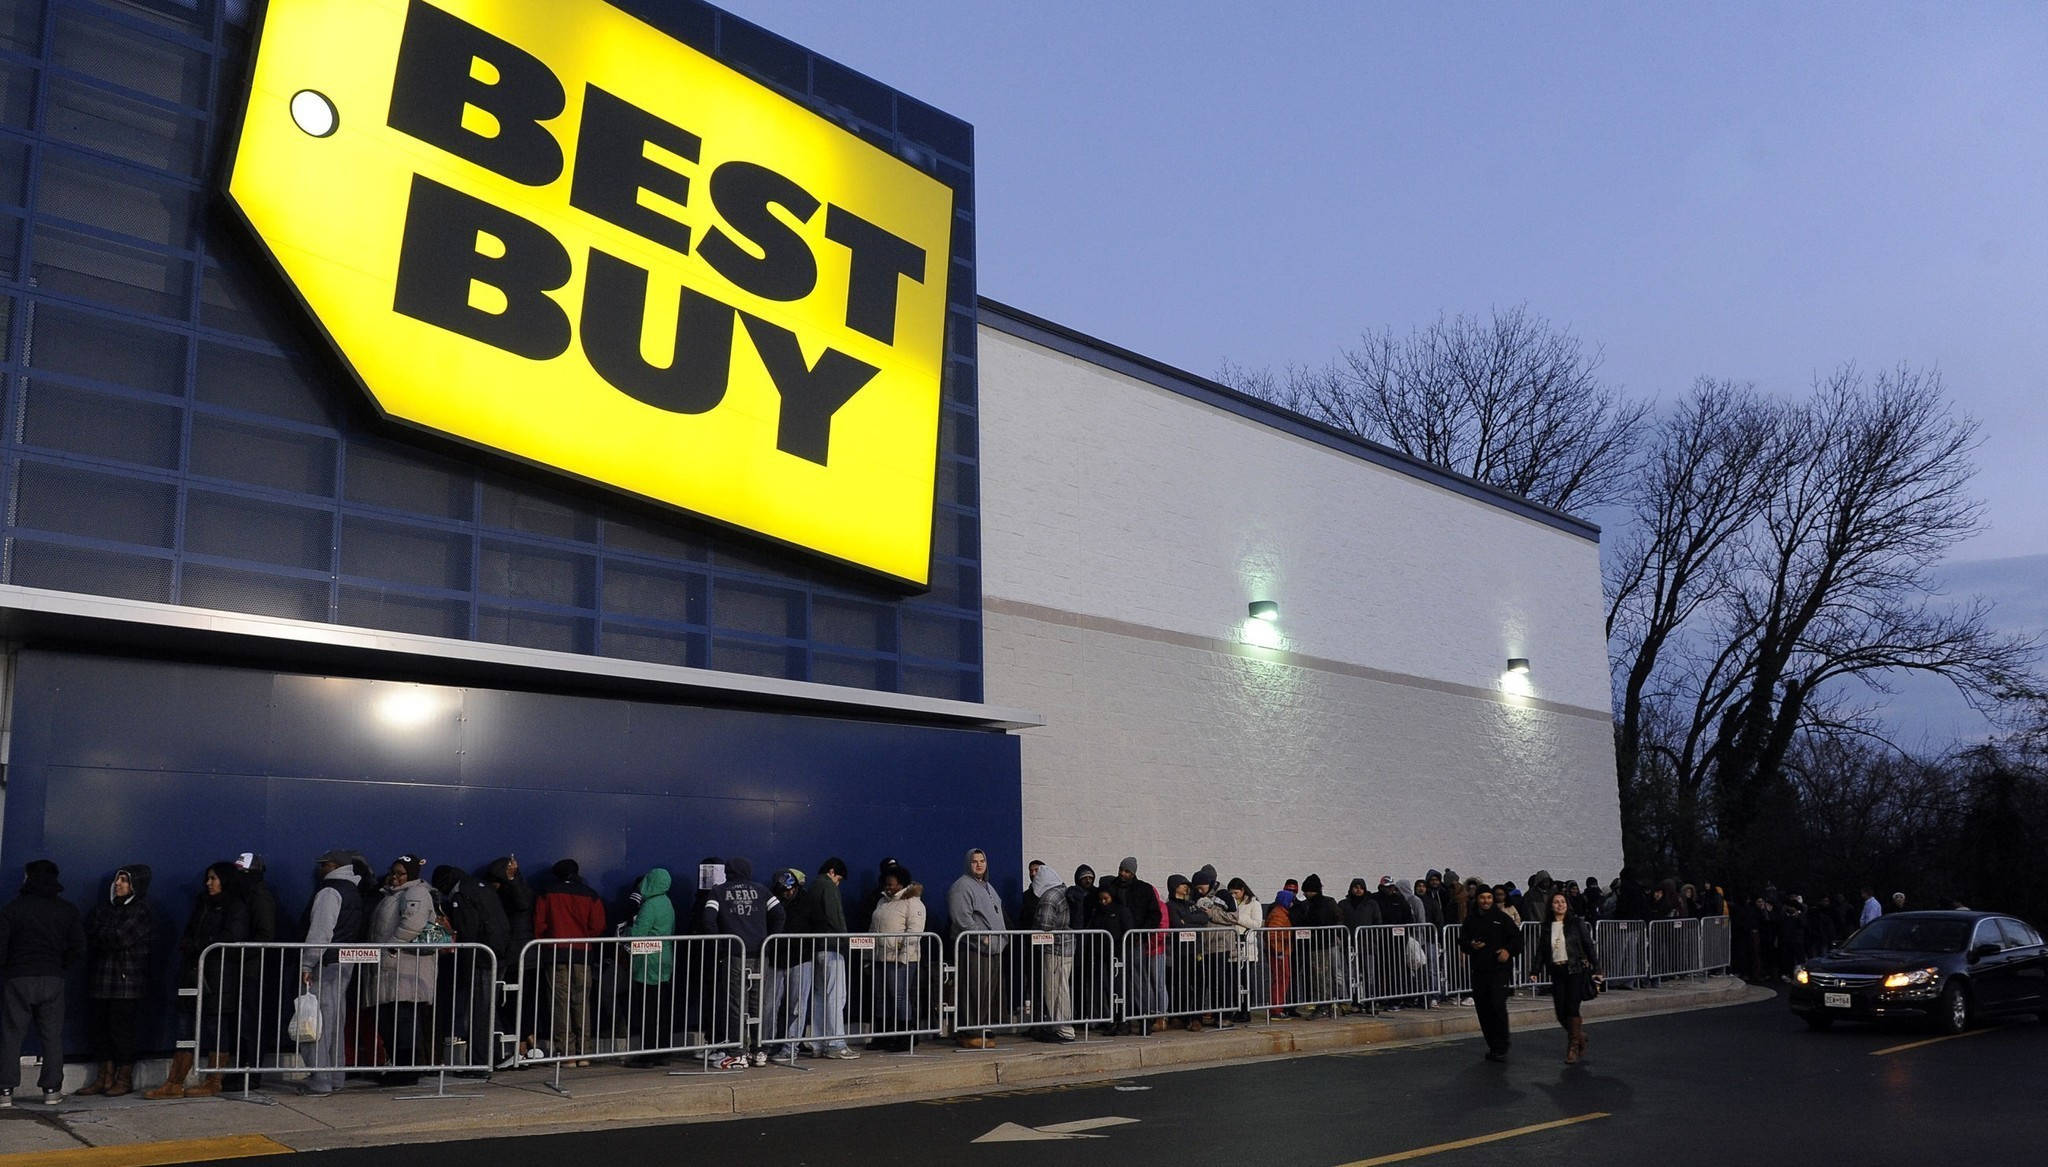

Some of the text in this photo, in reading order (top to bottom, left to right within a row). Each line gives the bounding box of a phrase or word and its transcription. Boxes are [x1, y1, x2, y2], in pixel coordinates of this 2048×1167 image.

[387, 0, 927, 347] BEST
[393, 172, 881, 467] BUY
[725, 889, 758, 900] AERO
[737, 904, 752, 916] 87
